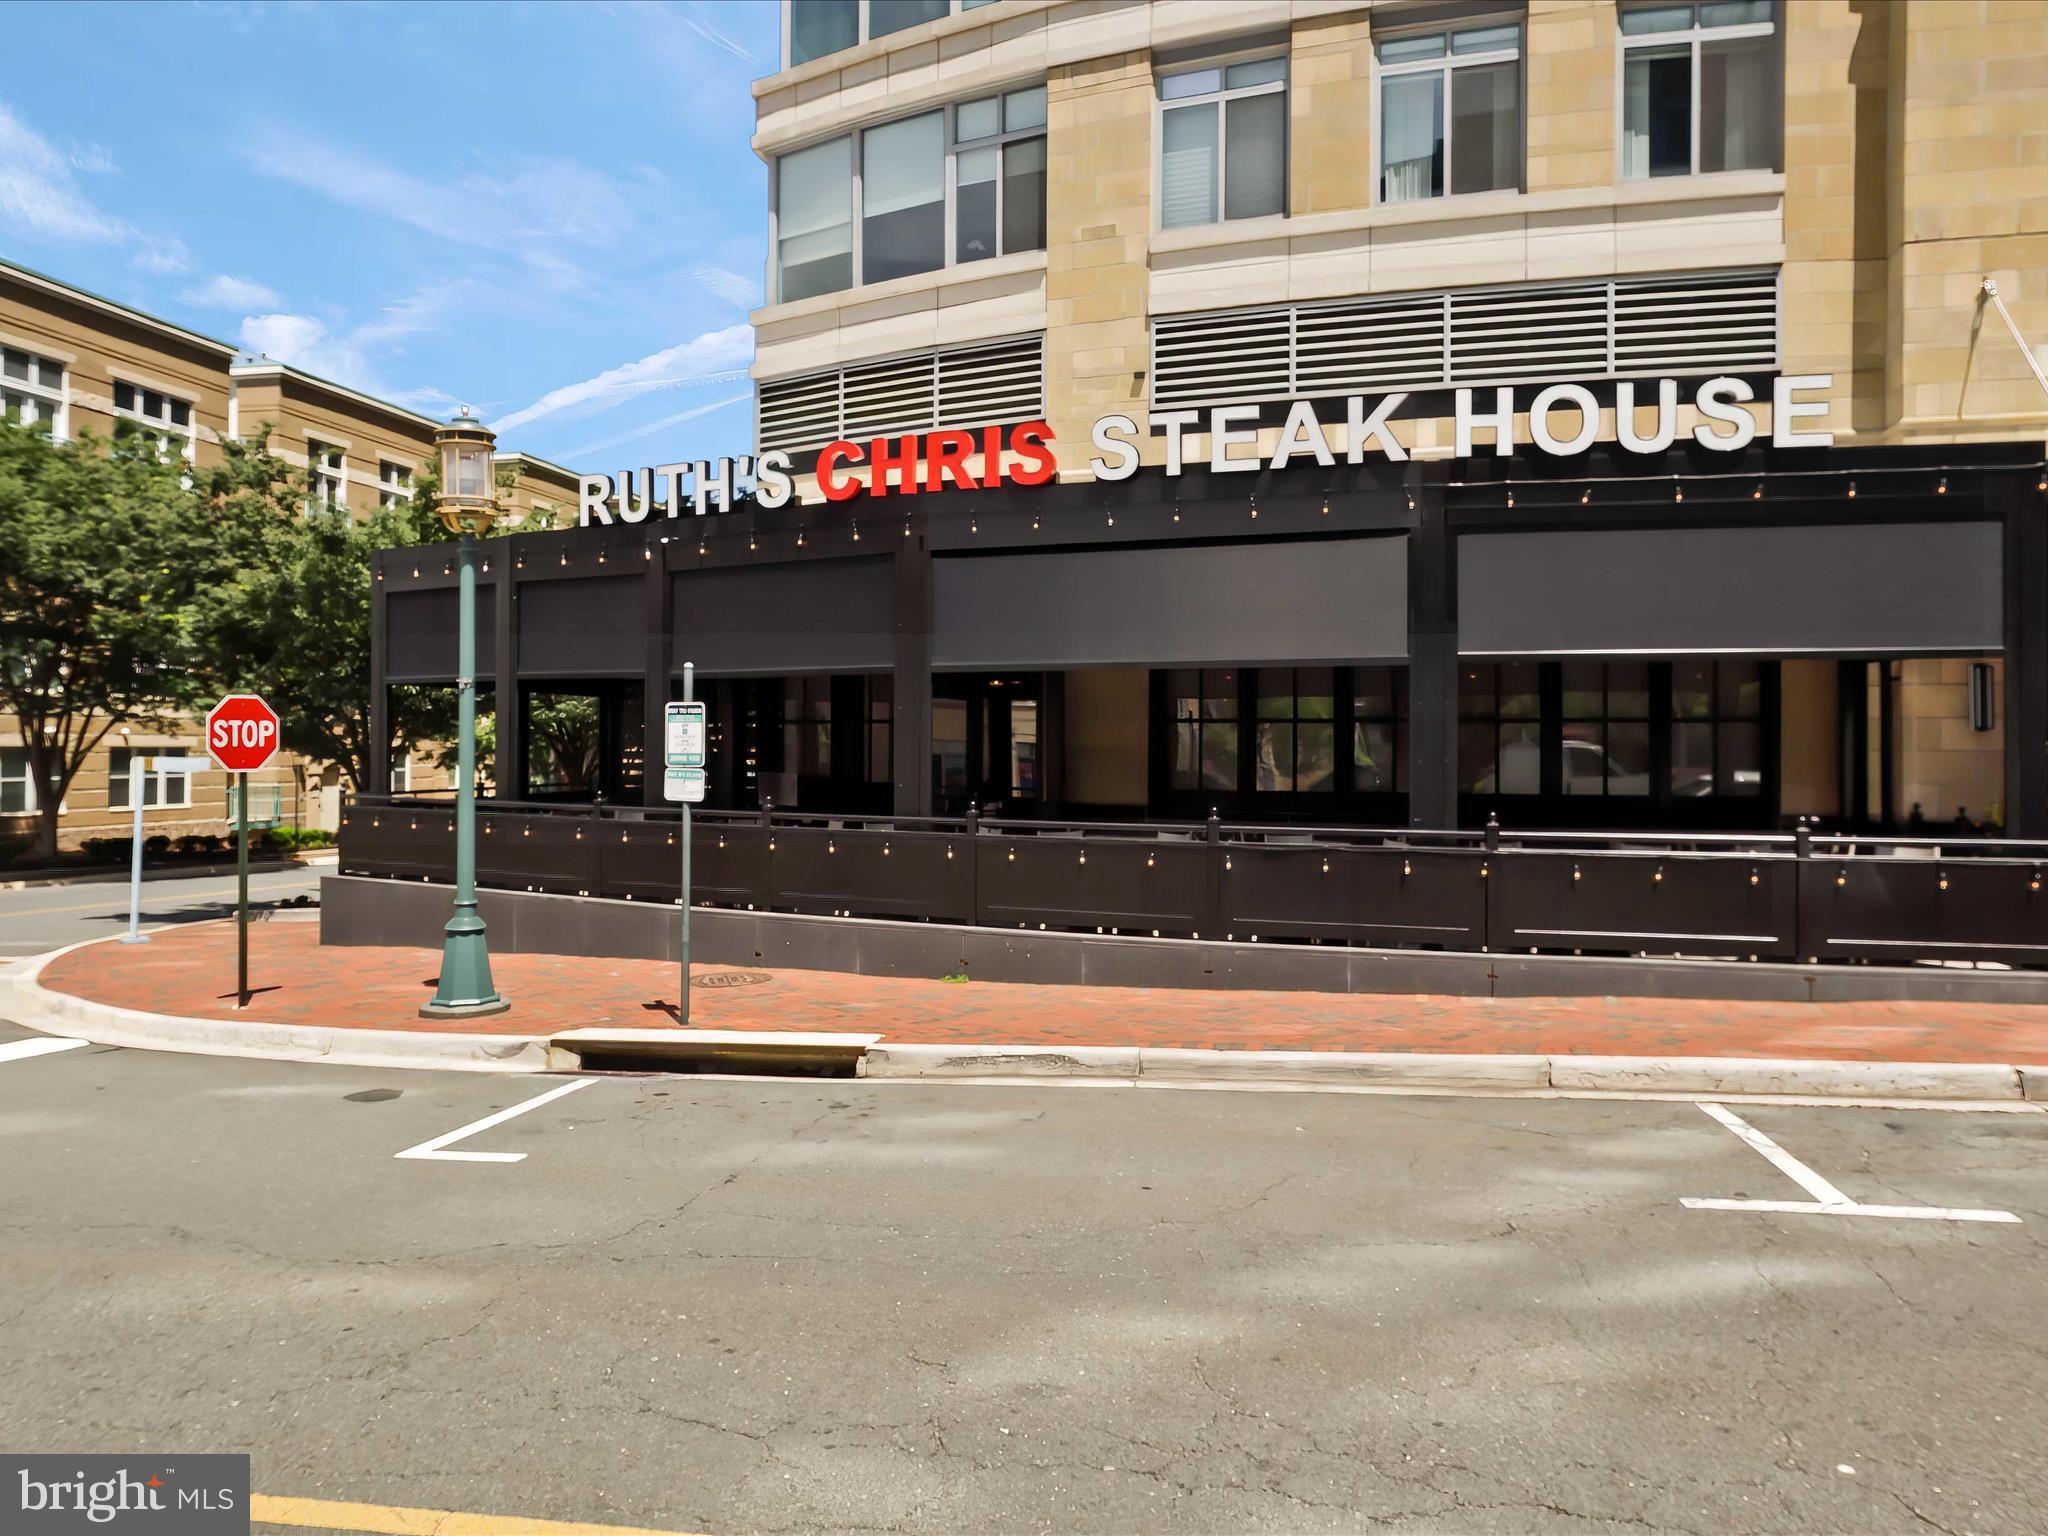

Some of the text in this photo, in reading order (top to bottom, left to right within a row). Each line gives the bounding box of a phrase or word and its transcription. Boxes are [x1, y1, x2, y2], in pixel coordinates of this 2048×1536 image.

[578, 374, 1834, 528] RUTH'S CHRIS STEAK HOUSE
[212, 719, 275, 748] STOP
